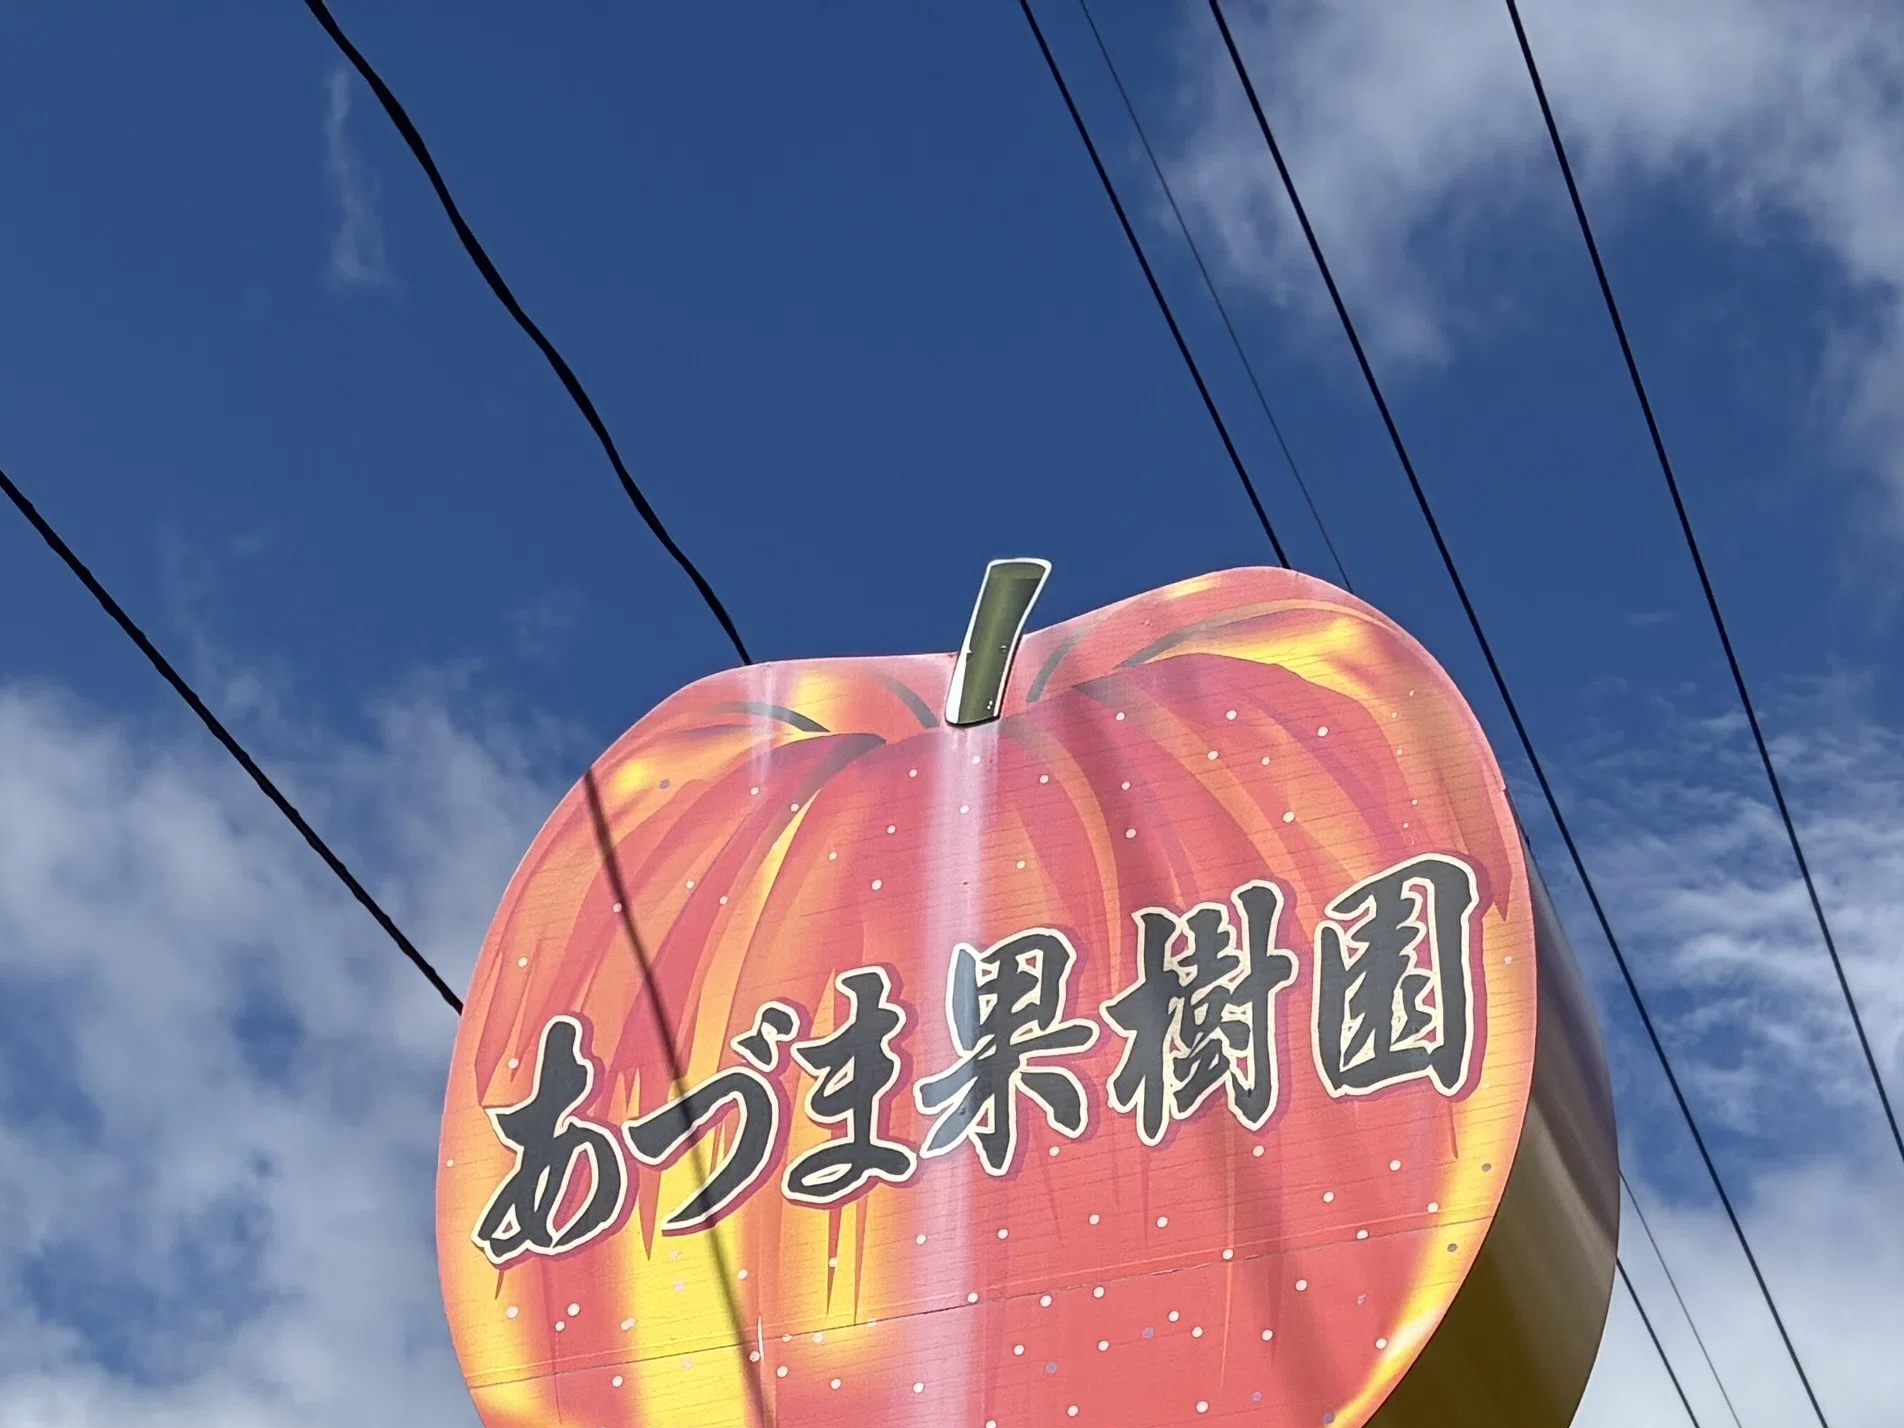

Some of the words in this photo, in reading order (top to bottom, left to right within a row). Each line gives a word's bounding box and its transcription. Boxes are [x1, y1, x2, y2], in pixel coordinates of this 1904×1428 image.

[471, 853, 1480, 1263] あづま果樹園
